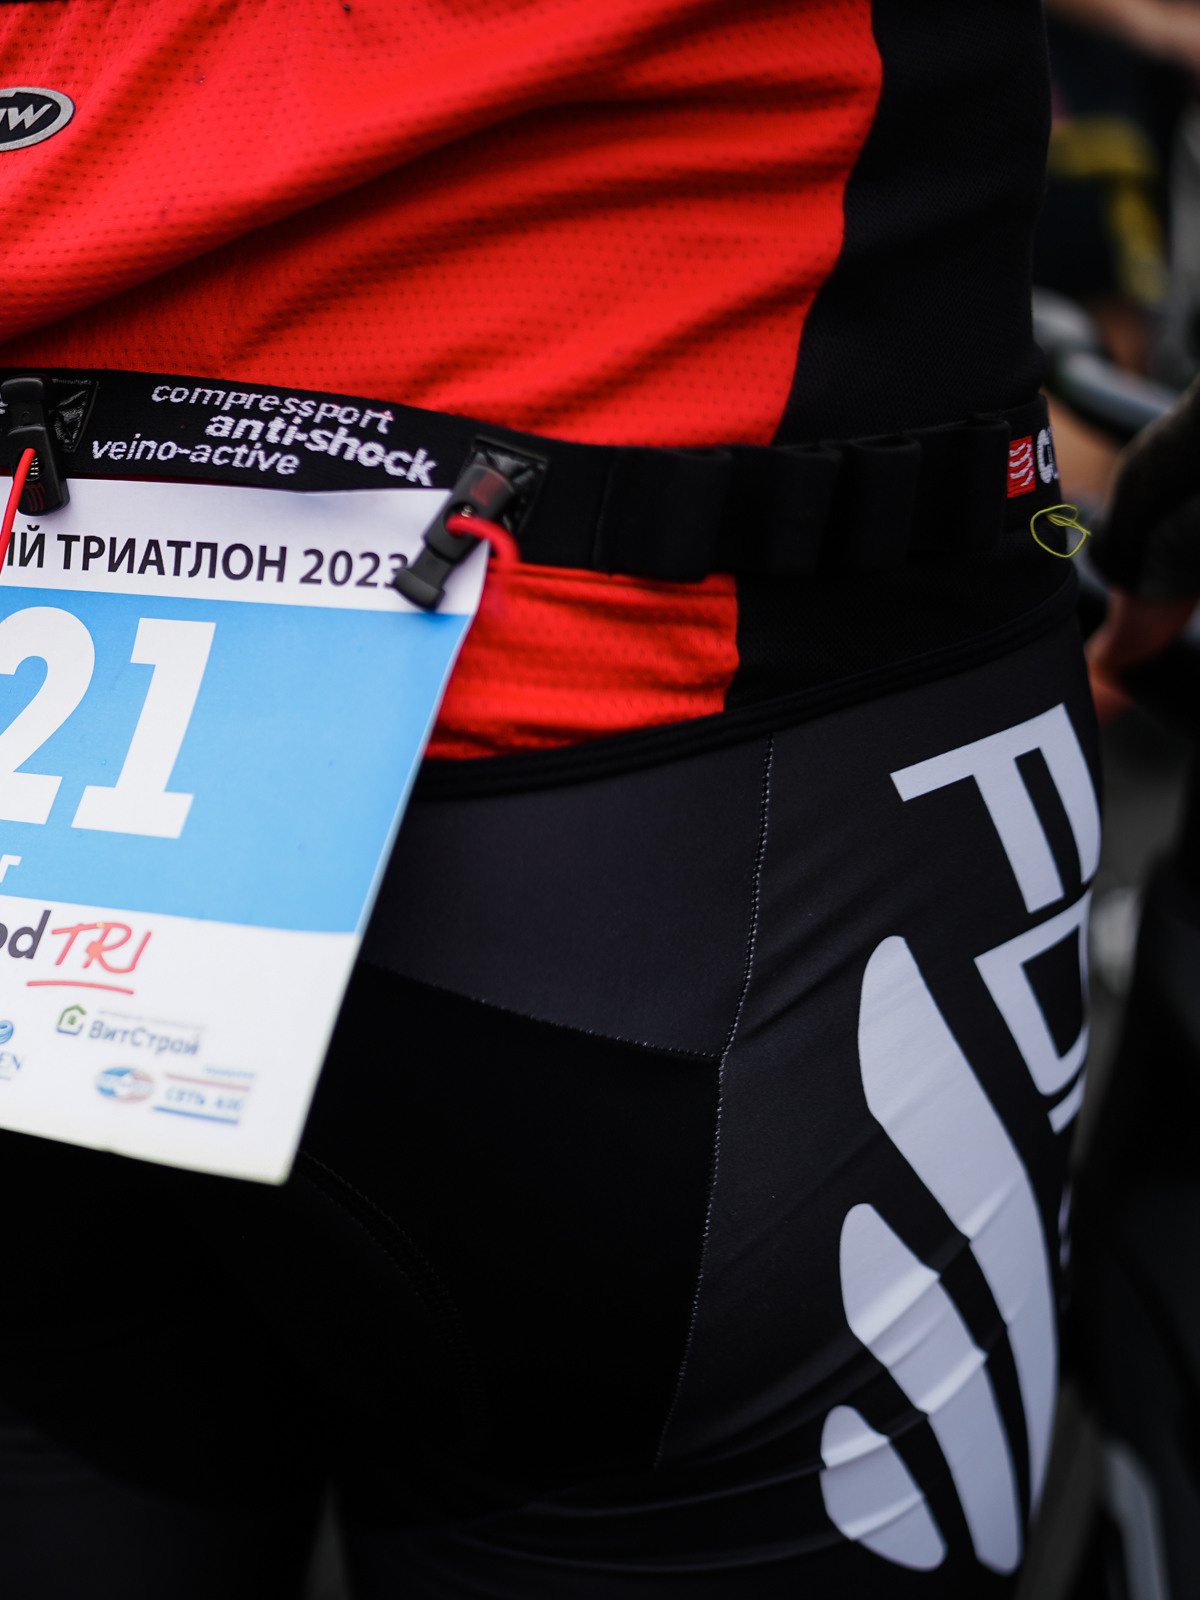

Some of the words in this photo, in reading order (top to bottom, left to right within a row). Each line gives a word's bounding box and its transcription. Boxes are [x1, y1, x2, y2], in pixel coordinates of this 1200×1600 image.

[151, 384, 396, 435] compressport
[92, 432, 300, 476] veino-active
[205, 412, 438, 487] anti-shock
[57, 533, 288, 583] ТРИАТЛОН
